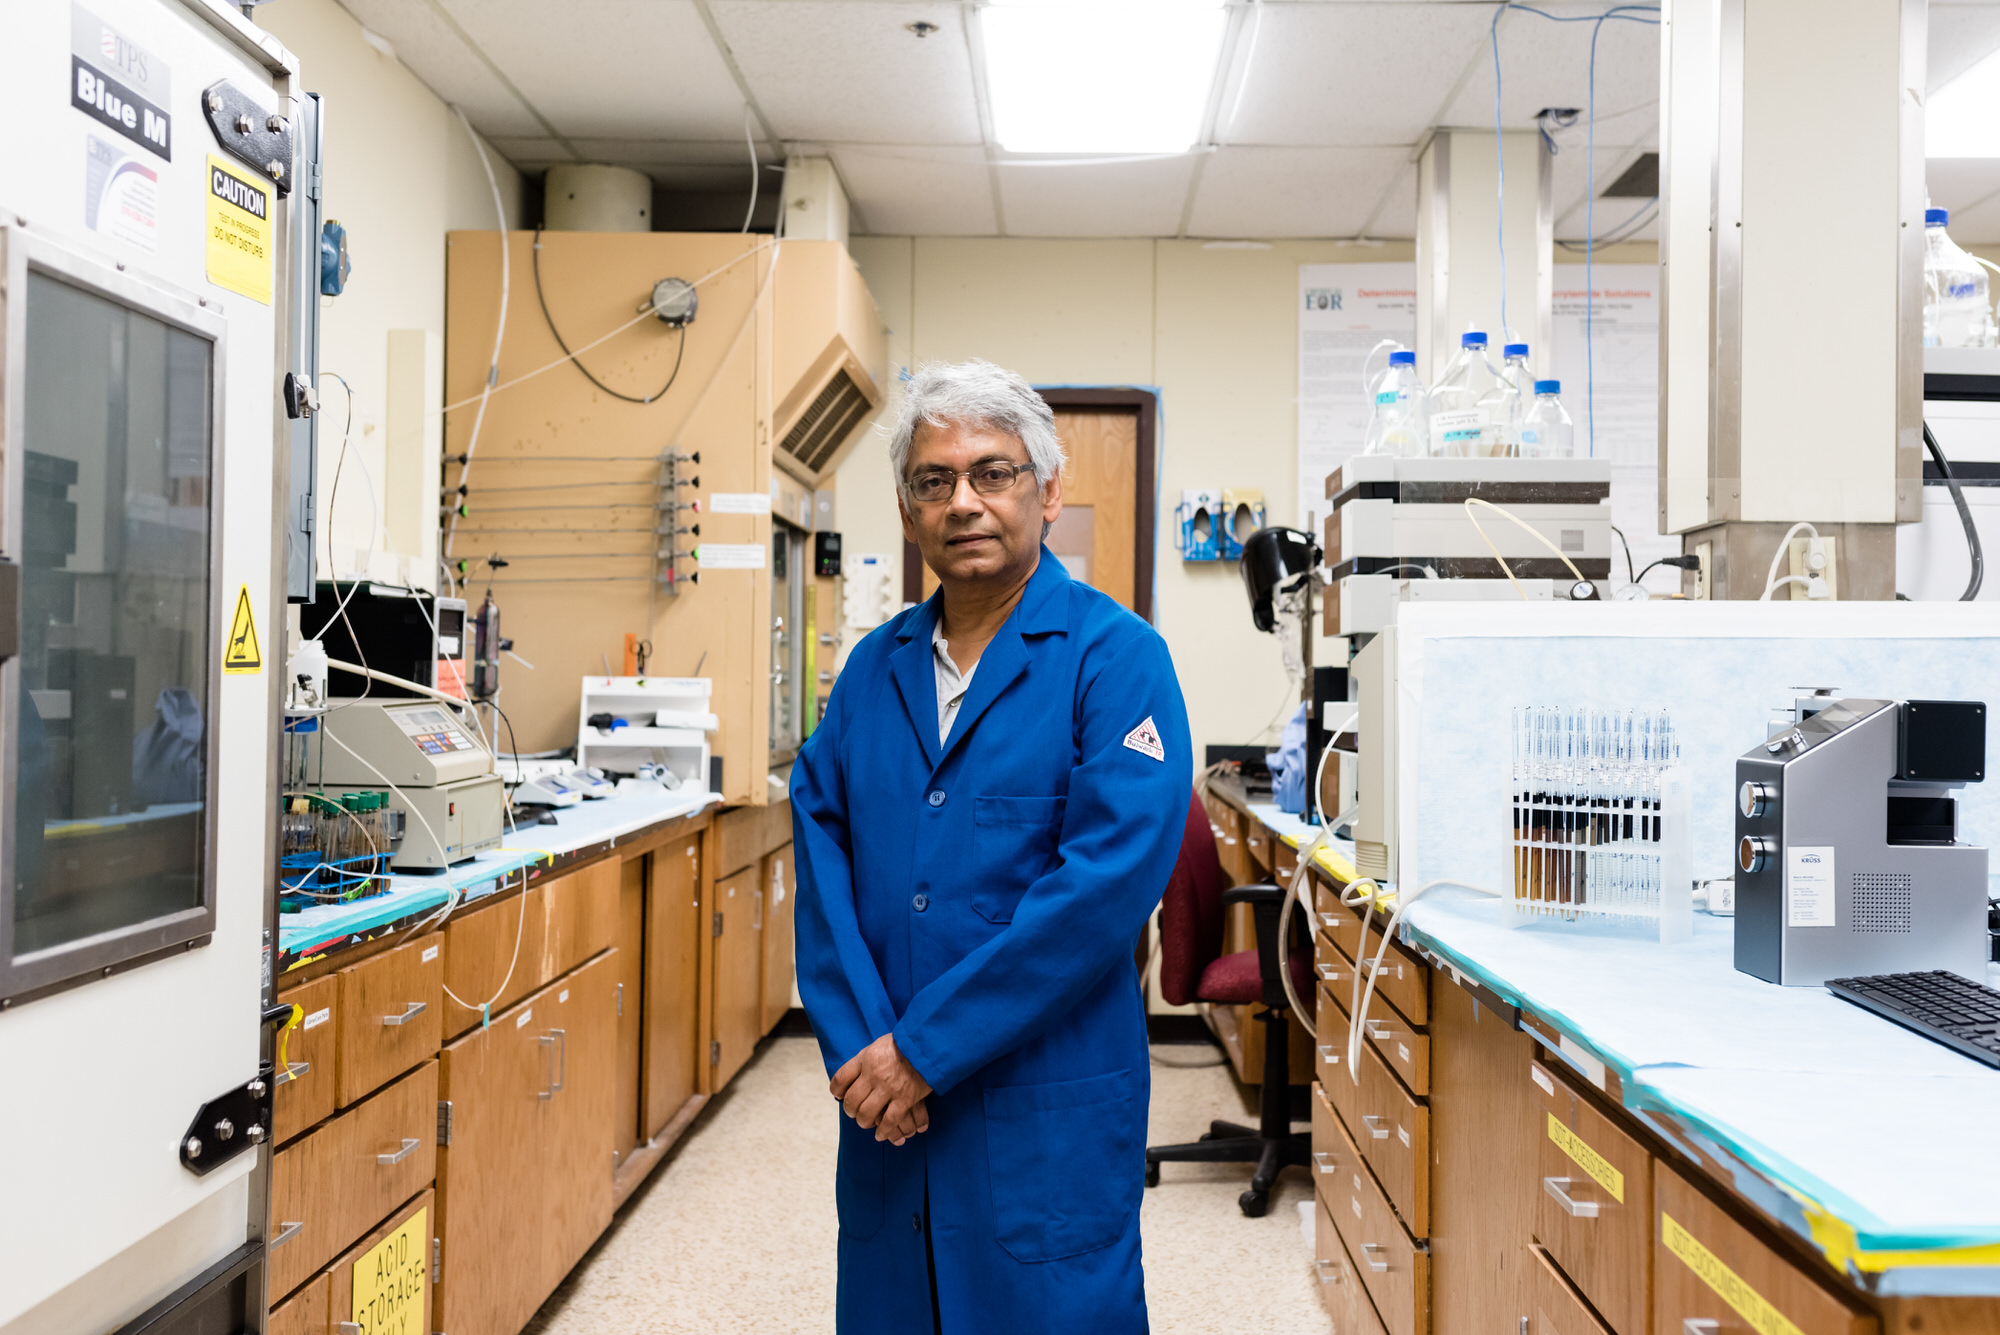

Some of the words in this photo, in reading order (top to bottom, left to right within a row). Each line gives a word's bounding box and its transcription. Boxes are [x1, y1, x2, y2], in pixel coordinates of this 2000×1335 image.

[116, 35, 148, 82] TPS
[77, 66, 137, 129] Blue
[143, 108, 167, 148] M
[213, 171, 264, 217] CAUTION
[214, 226, 225, 241] DO
[225, 231, 238, 247] NOT
[239, 237, 263, 258] DISTURB
[218, 211, 230, 225] TEST
[231, 218, 236, 227] IN
[236, 220, 260, 240] PROGRESS
[1604, 288, 1651, 299] Solutions
[1801, 856, 1821, 864] KRÜSS
[1554, 1122, 1616, 1192] SDT-ACCESSORIES
[375, 1233, 407, 1288] ACID
[358, 1258, 421, 1335] STORAGE
